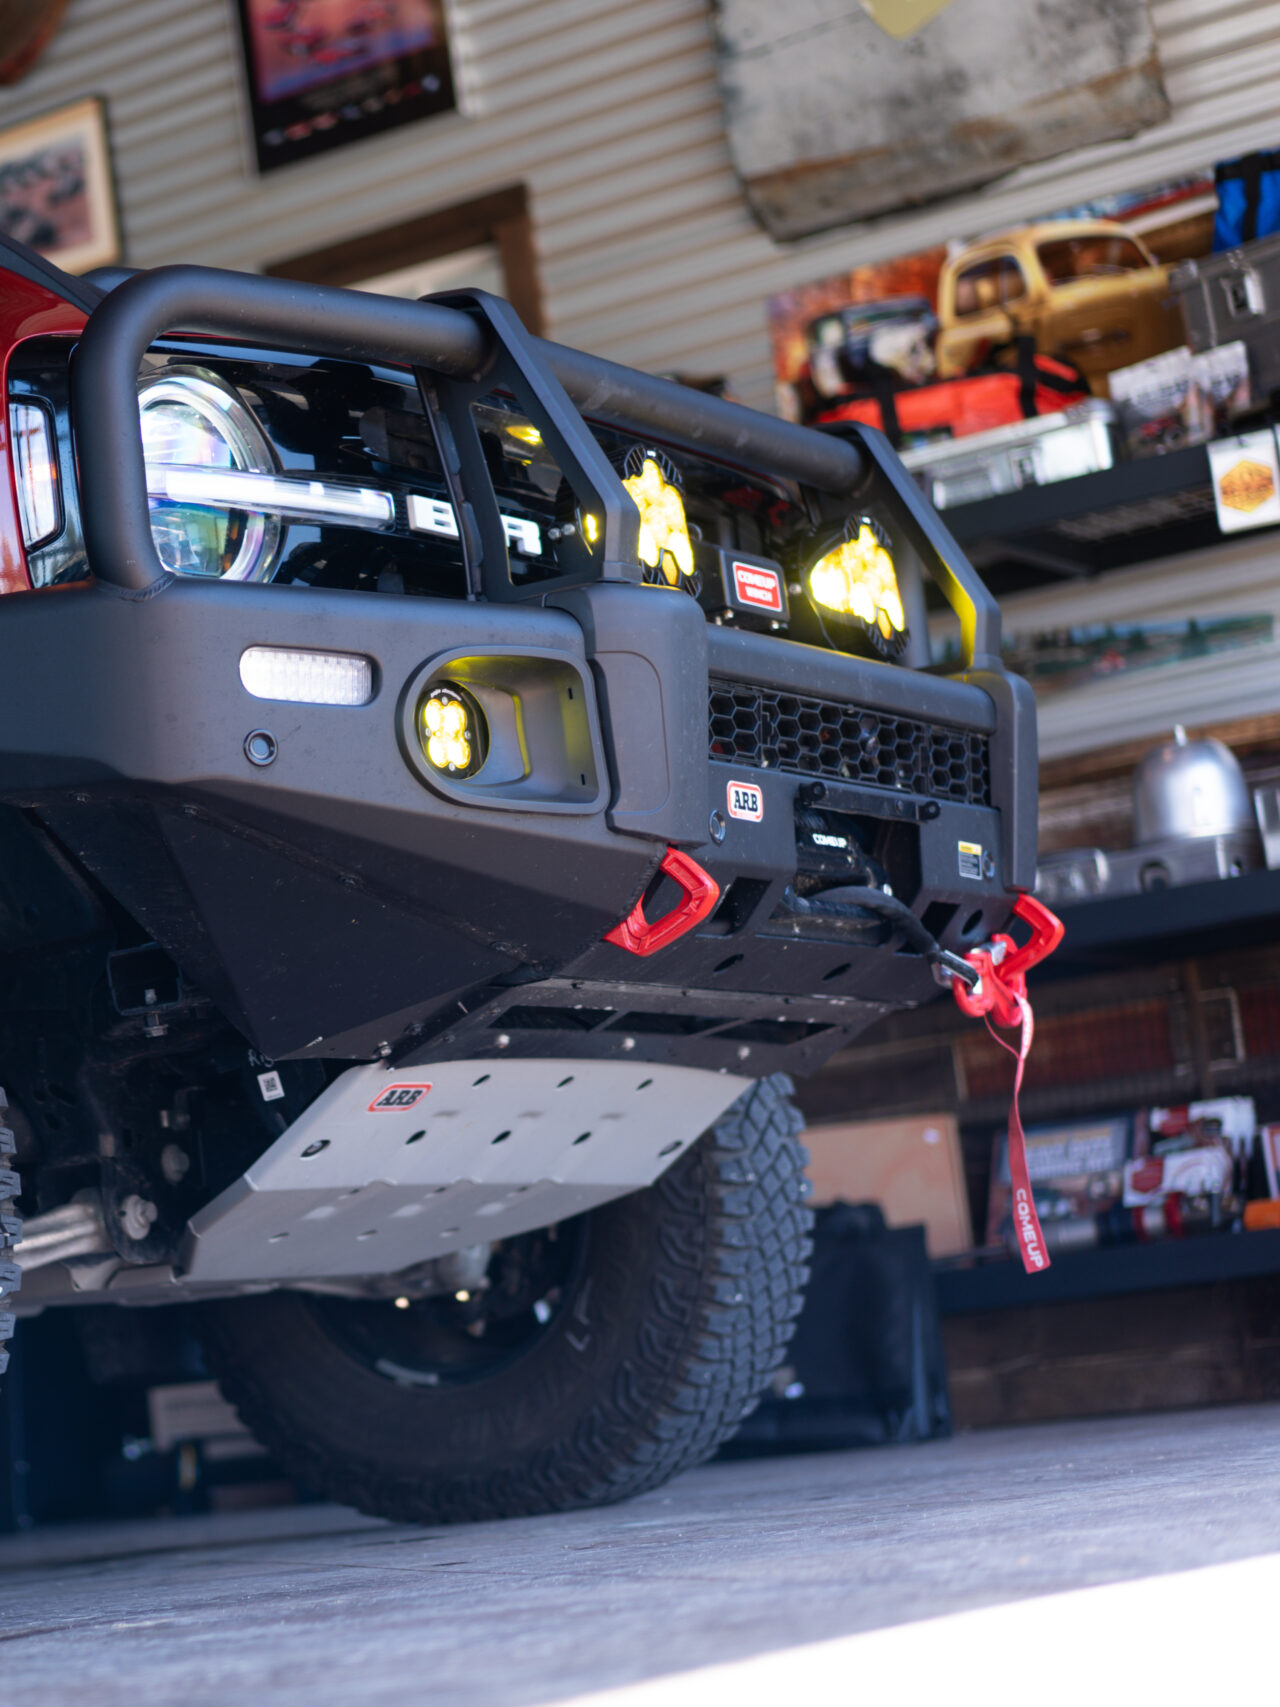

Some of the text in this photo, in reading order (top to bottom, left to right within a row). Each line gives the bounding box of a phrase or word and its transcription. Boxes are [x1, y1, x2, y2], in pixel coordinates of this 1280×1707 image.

[733, 789, 759, 813] ARB
[375, 1088, 425, 1107] ARB
[1016, 1187, 1045, 1270] COMEUP
